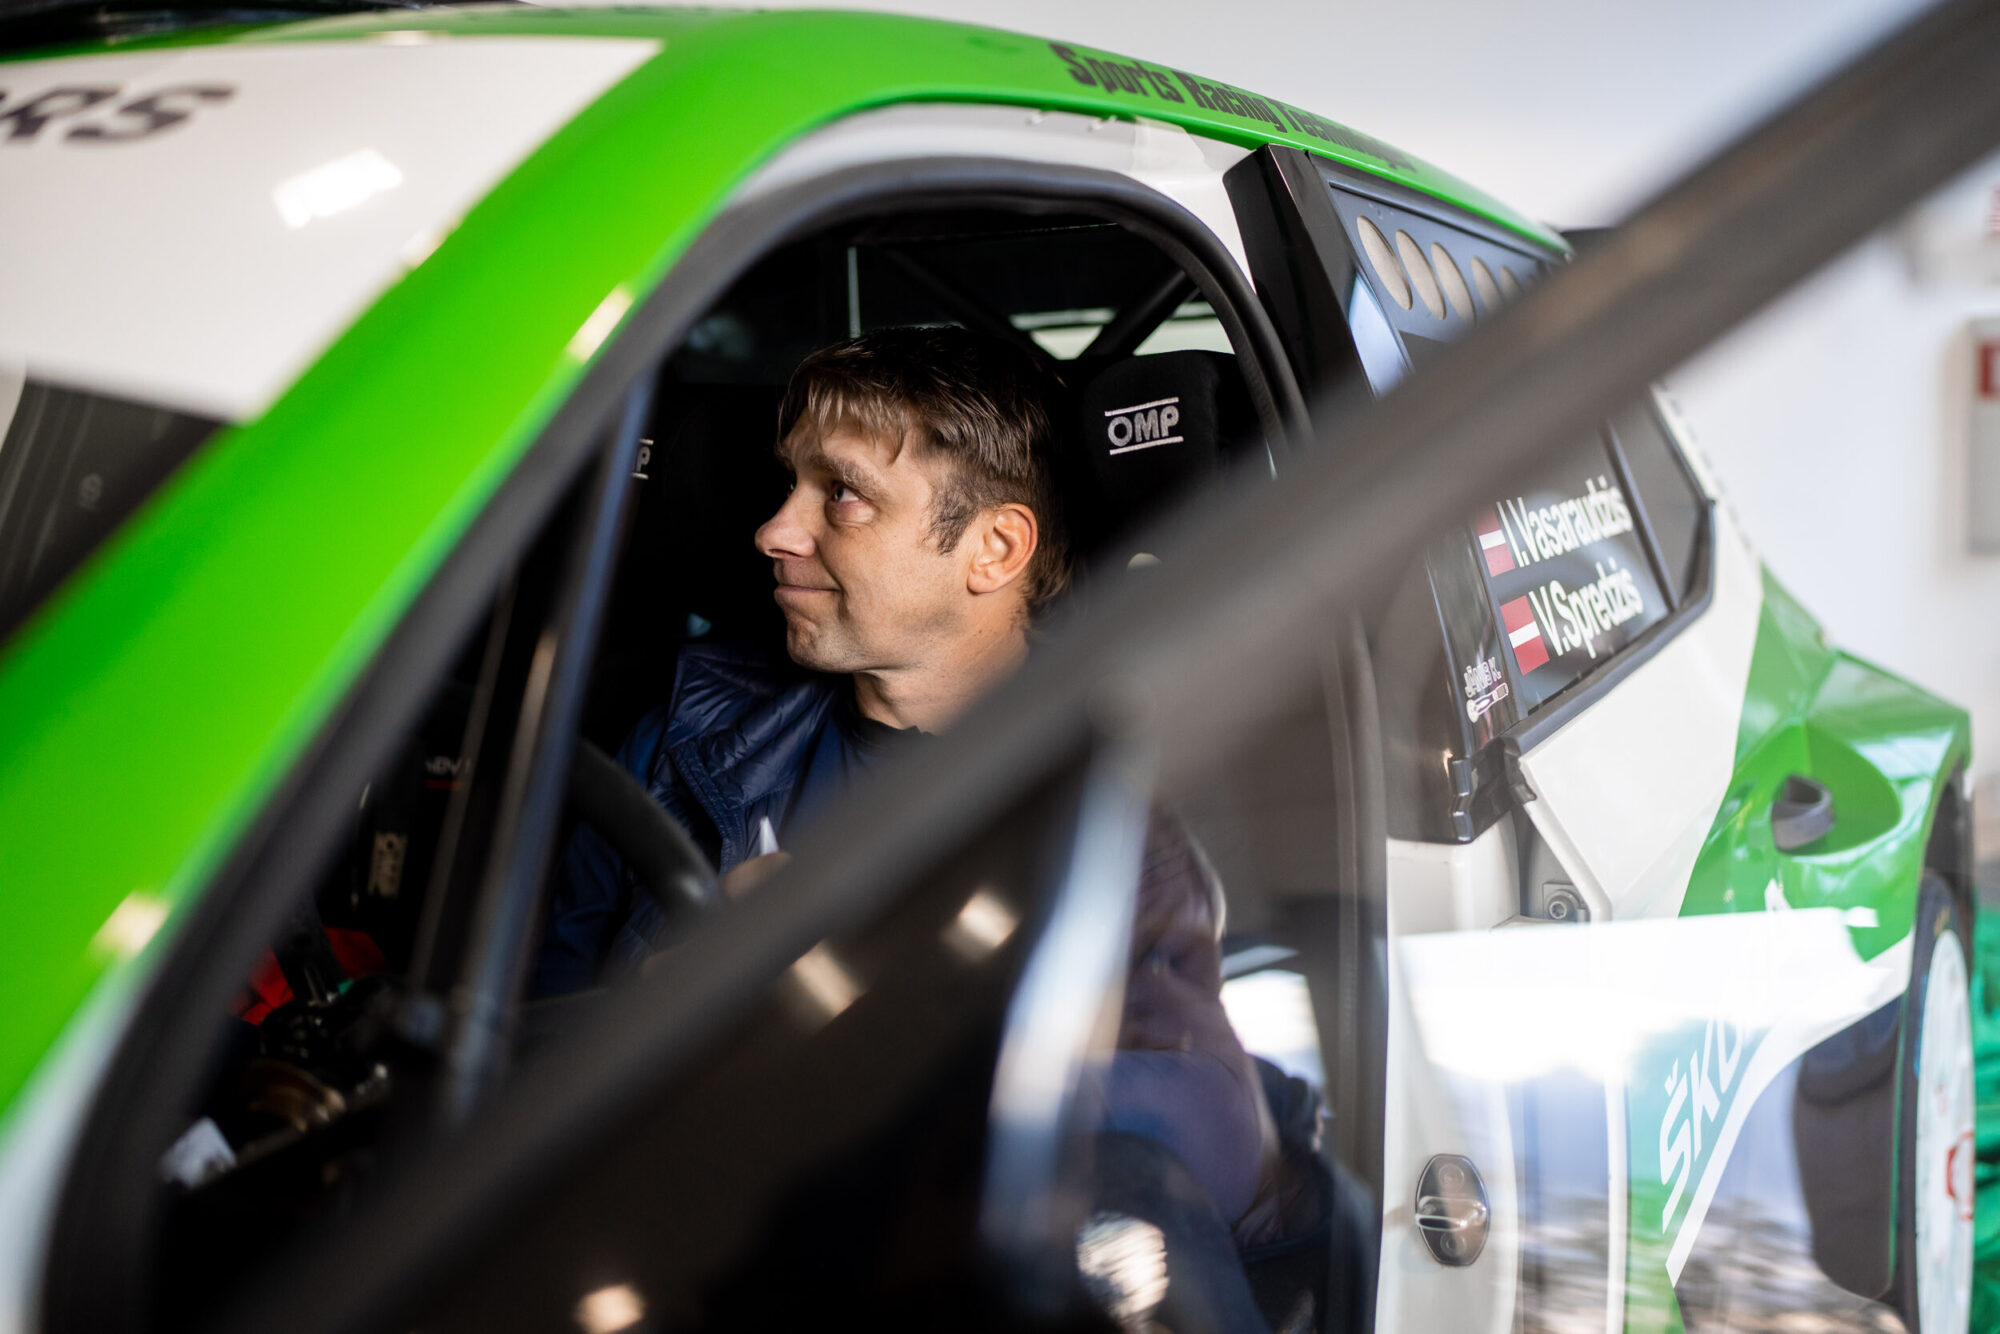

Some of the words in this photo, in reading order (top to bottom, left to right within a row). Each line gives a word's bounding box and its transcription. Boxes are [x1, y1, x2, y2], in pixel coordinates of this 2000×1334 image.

[0, 86, 236, 141] RS
[1048, 43, 1185, 103] Sports
[1173, 70, 1288, 134] Racing
[1107, 404, 1180, 447] OMP
